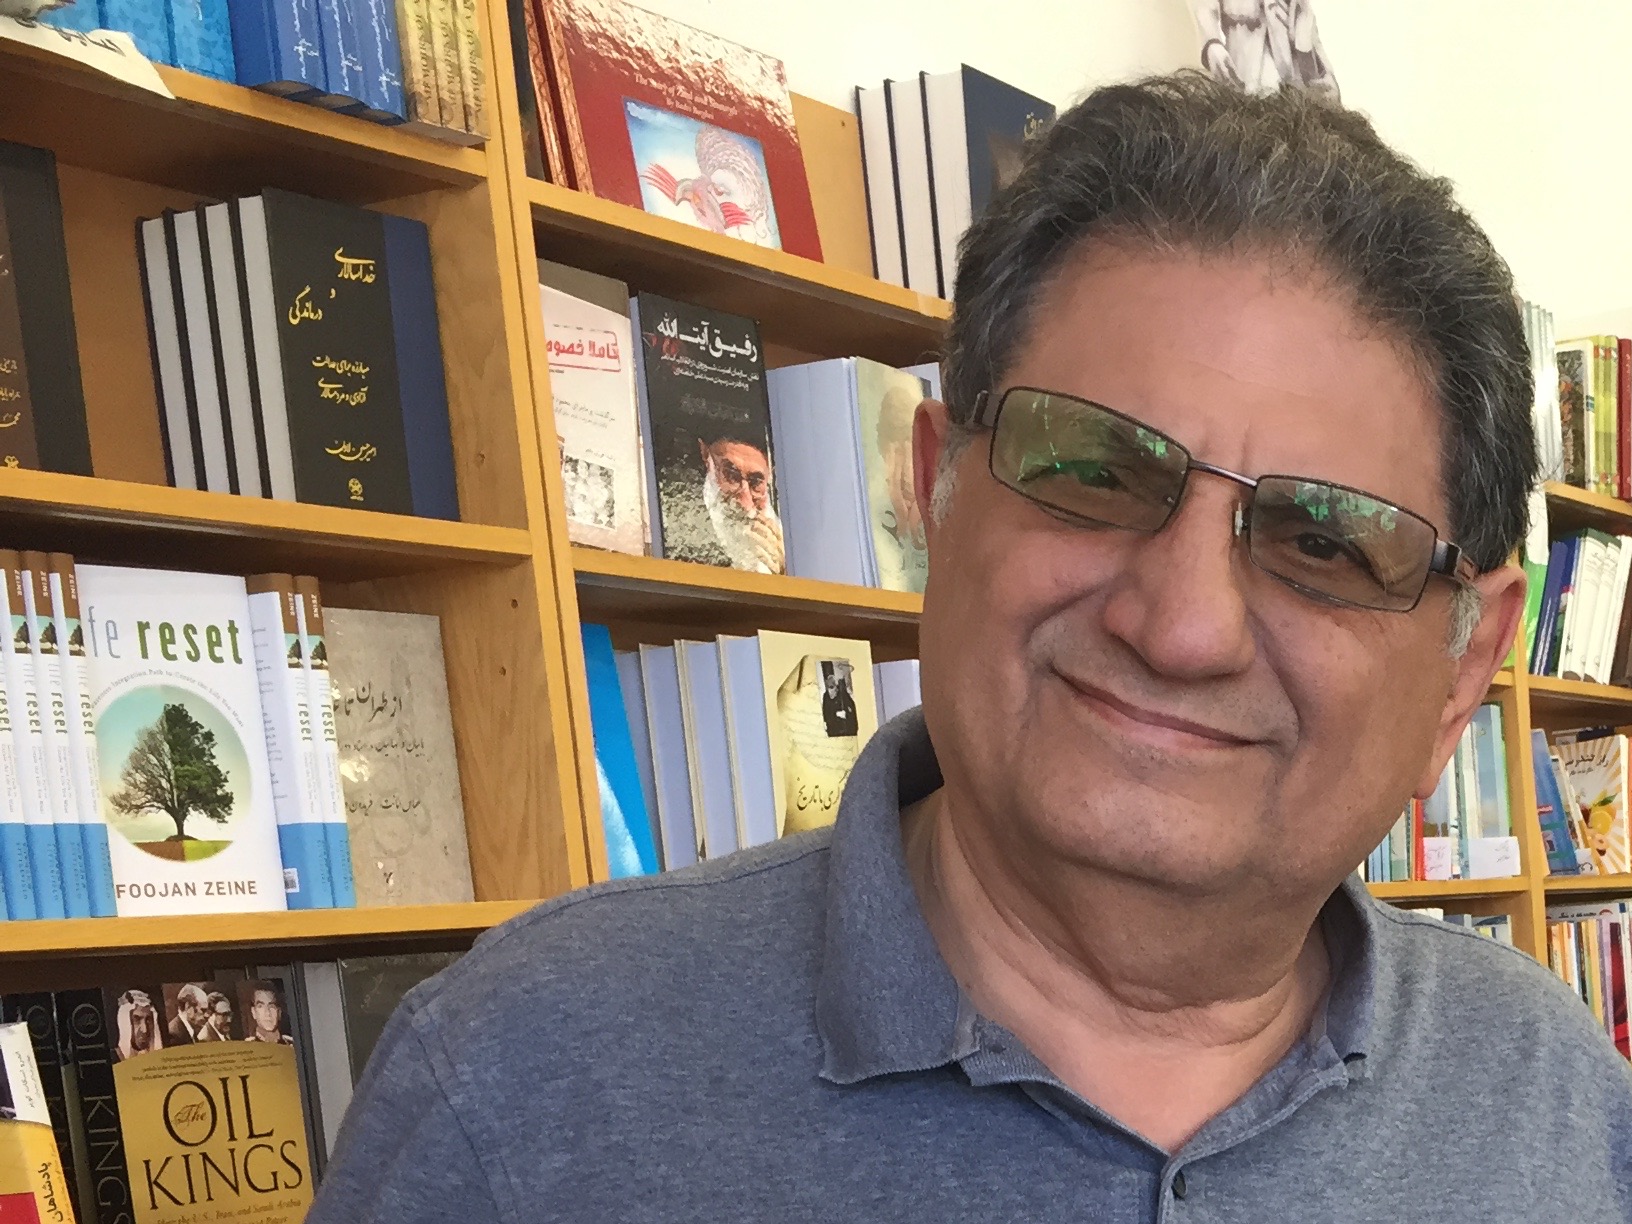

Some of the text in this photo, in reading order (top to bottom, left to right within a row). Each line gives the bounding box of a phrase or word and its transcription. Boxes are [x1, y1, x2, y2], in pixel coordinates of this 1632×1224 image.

[329, 287, 337, 299] و
[708, 328, 758, 363] رفیق
[136, 619, 243, 665] reset
[26, 692, 42, 735] reset
[51, 692, 68, 735] reset
[80, 693, 96, 736] reset
[356, 681, 389, 722] طهران
[390, 695, 403, 718] از
[298, 702, 313, 742] reset
[320, 703, 337, 743] reset
[115, 880, 258, 899] FOOJAN ZEINE
[162, 1073, 275, 1148] OIL
[172, 1100, 208, 1132] The
[37, 1161, 64, 1223] پادشاهان
[142, 1139, 304, 1211] KINGS
[236, 1204, 252, 1218] and
